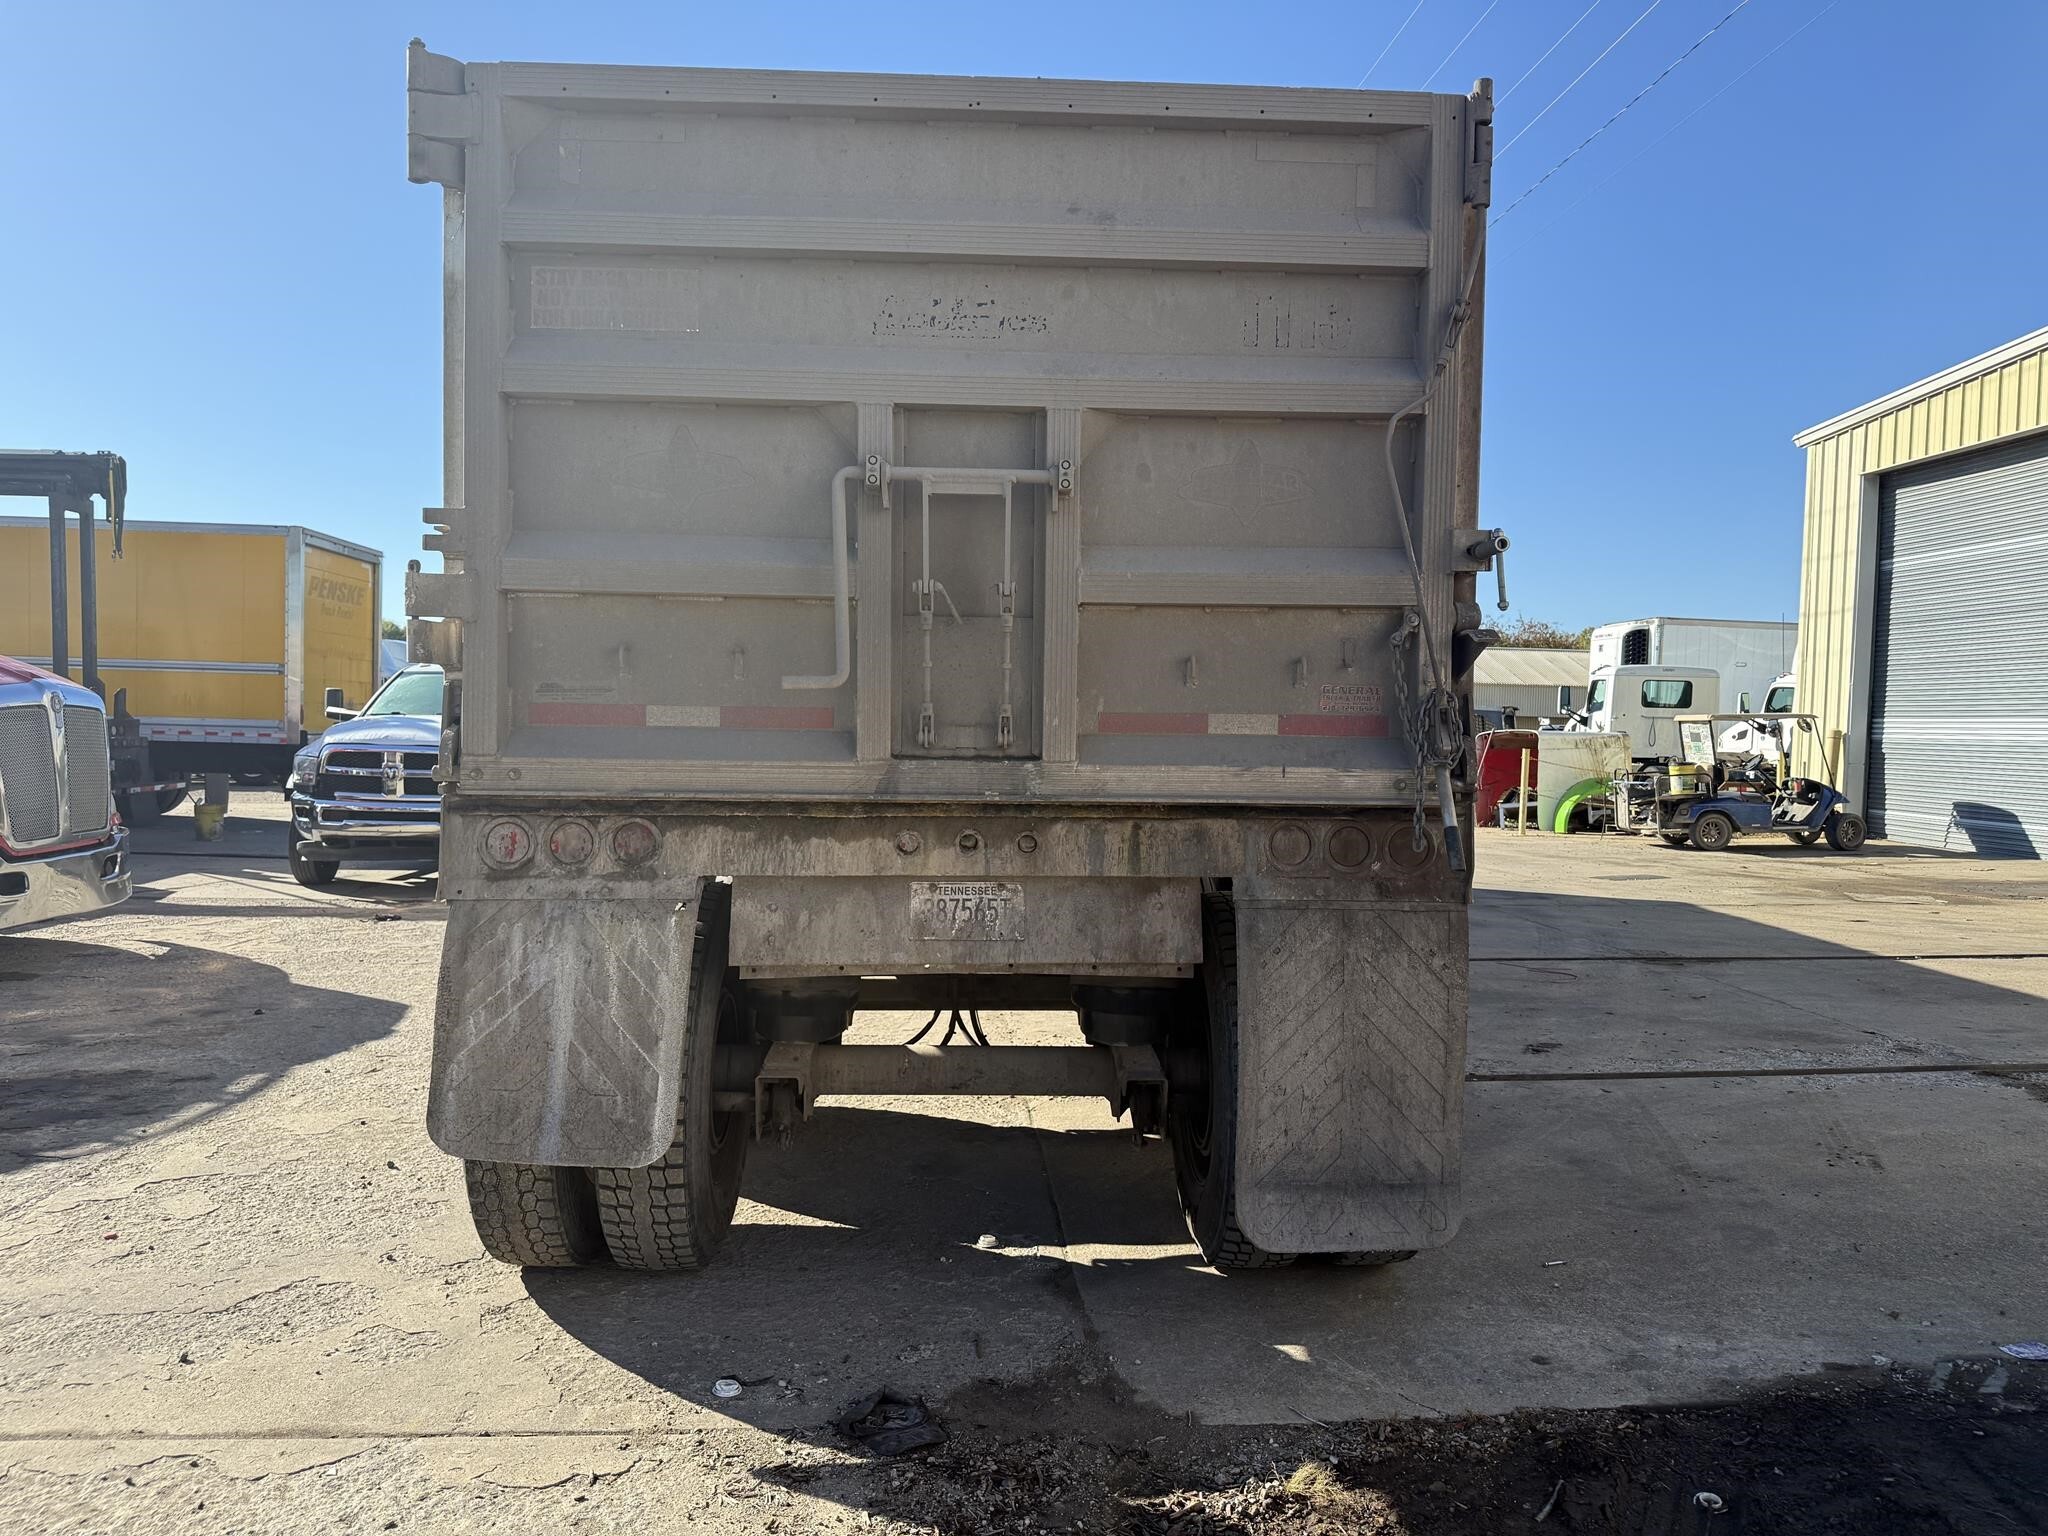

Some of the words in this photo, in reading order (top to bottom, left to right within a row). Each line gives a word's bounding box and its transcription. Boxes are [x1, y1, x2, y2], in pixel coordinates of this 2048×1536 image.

[308, 575, 366, 606] PENSKE
[1322, 684, 1382, 696] GENERAL
[938, 886, 997, 896] TENNESSEE
